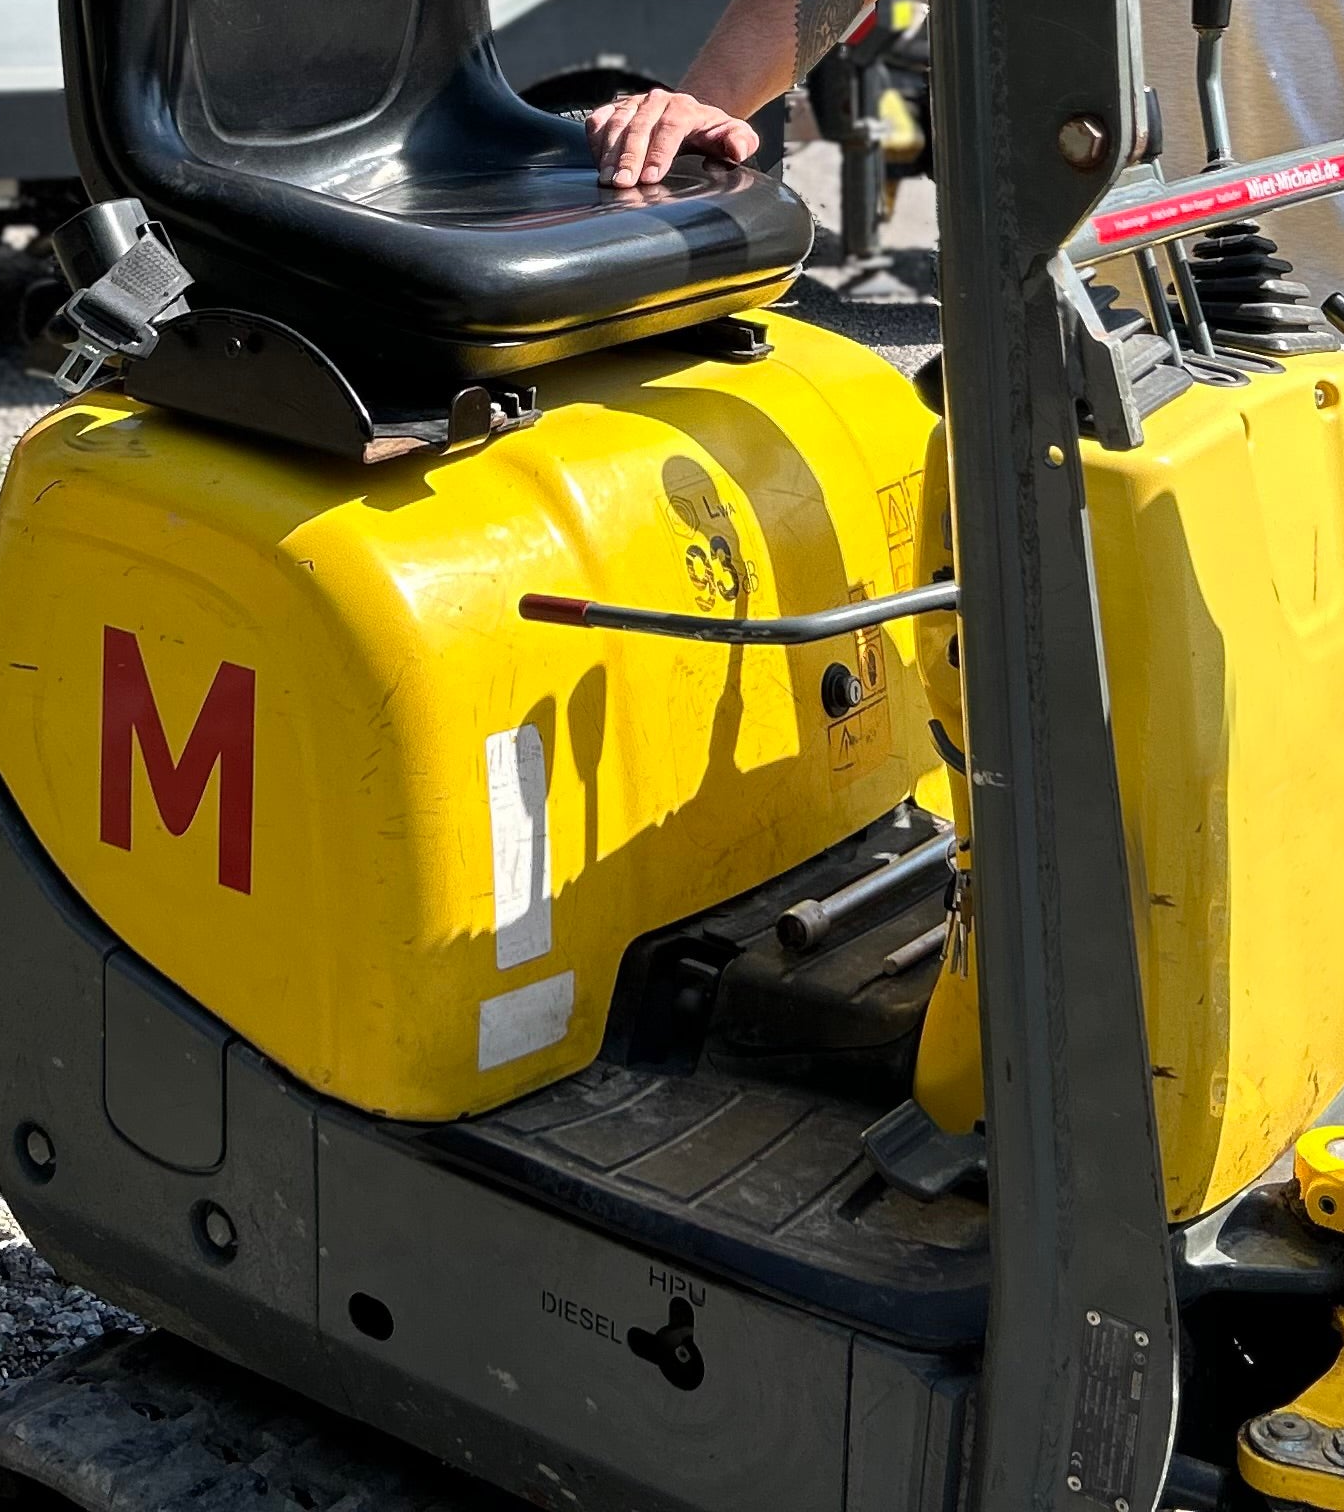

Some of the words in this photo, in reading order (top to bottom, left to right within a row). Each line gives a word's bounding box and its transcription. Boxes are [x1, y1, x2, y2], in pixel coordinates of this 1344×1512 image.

[1245, 159, 1340, 201] Miet-Michael.de
[685, 535, 739, 612] 93
[100, 624, 256, 896] M
[649, 1265, 706, 1308] HPU
[541, 1290, 622, 1345] DIESEL
